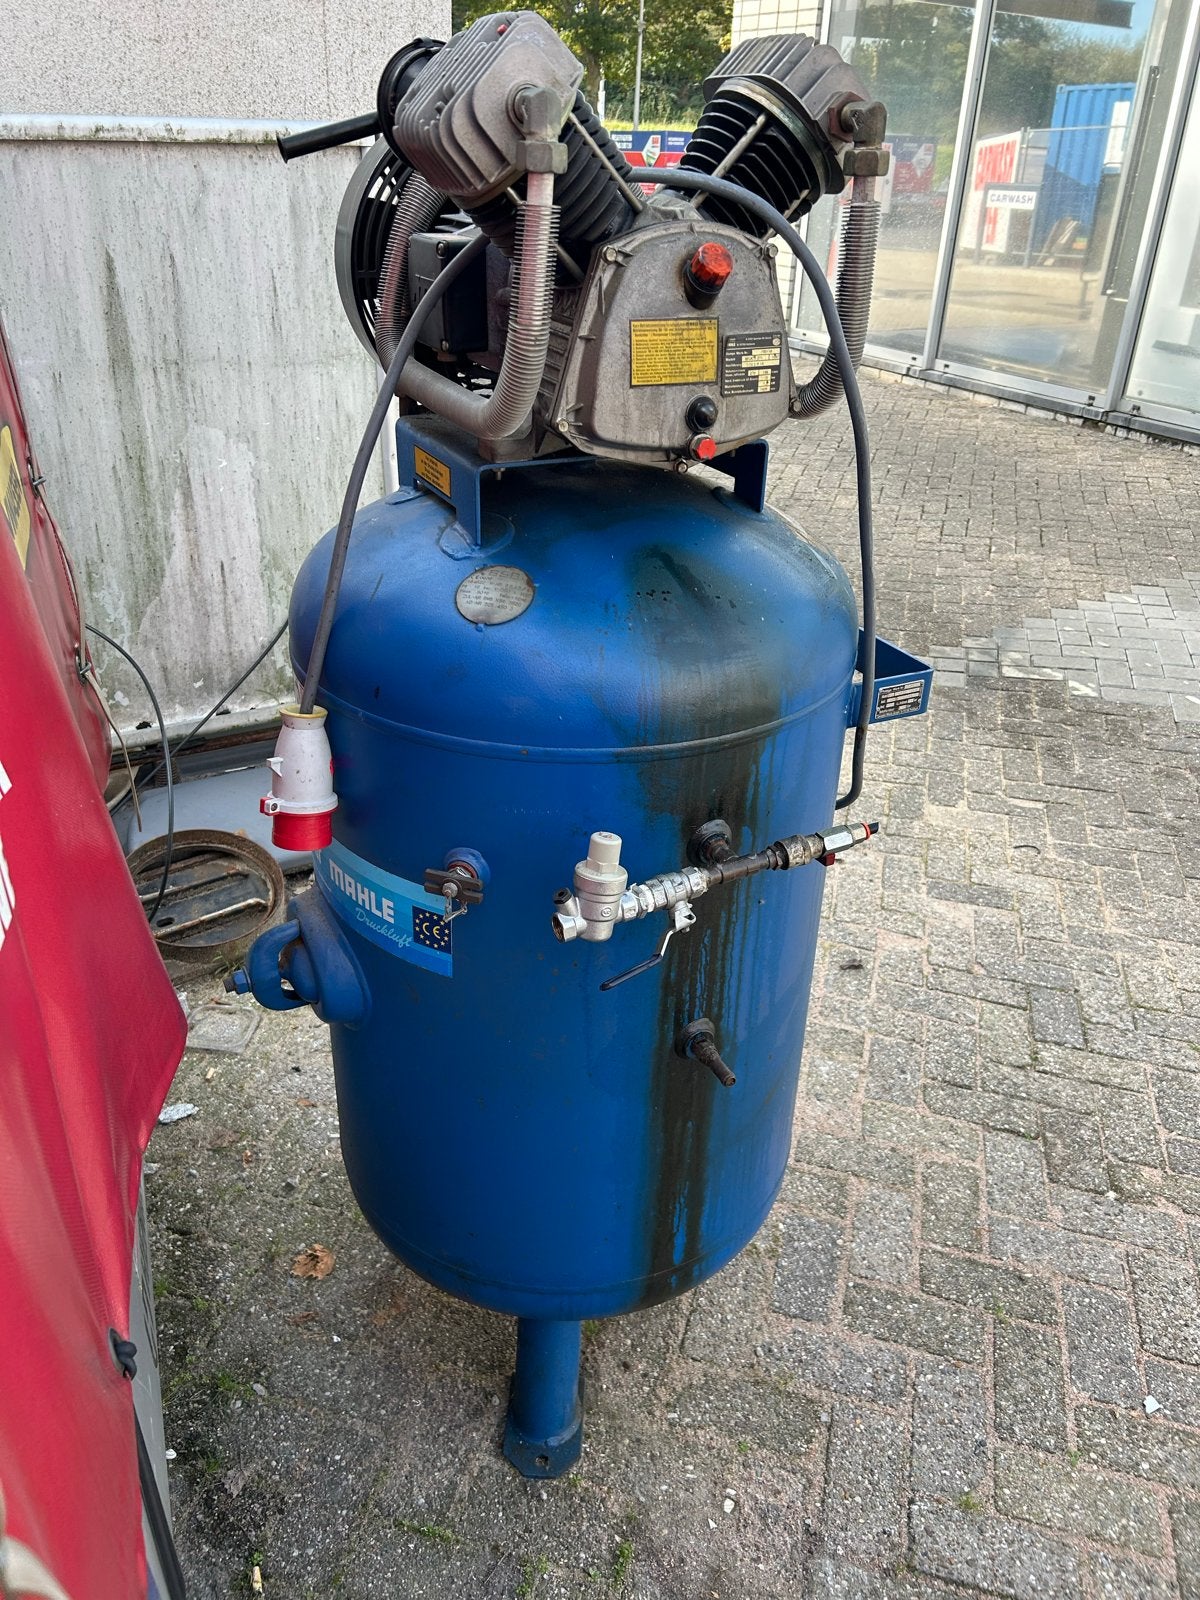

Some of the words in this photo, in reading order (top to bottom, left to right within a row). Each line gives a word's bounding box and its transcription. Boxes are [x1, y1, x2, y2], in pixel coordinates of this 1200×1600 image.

[990, 193, 1034, 205] CARWASH
[329, 858, 395, 924] MAHLE
[355, 907, 413, 949] Druckluft
